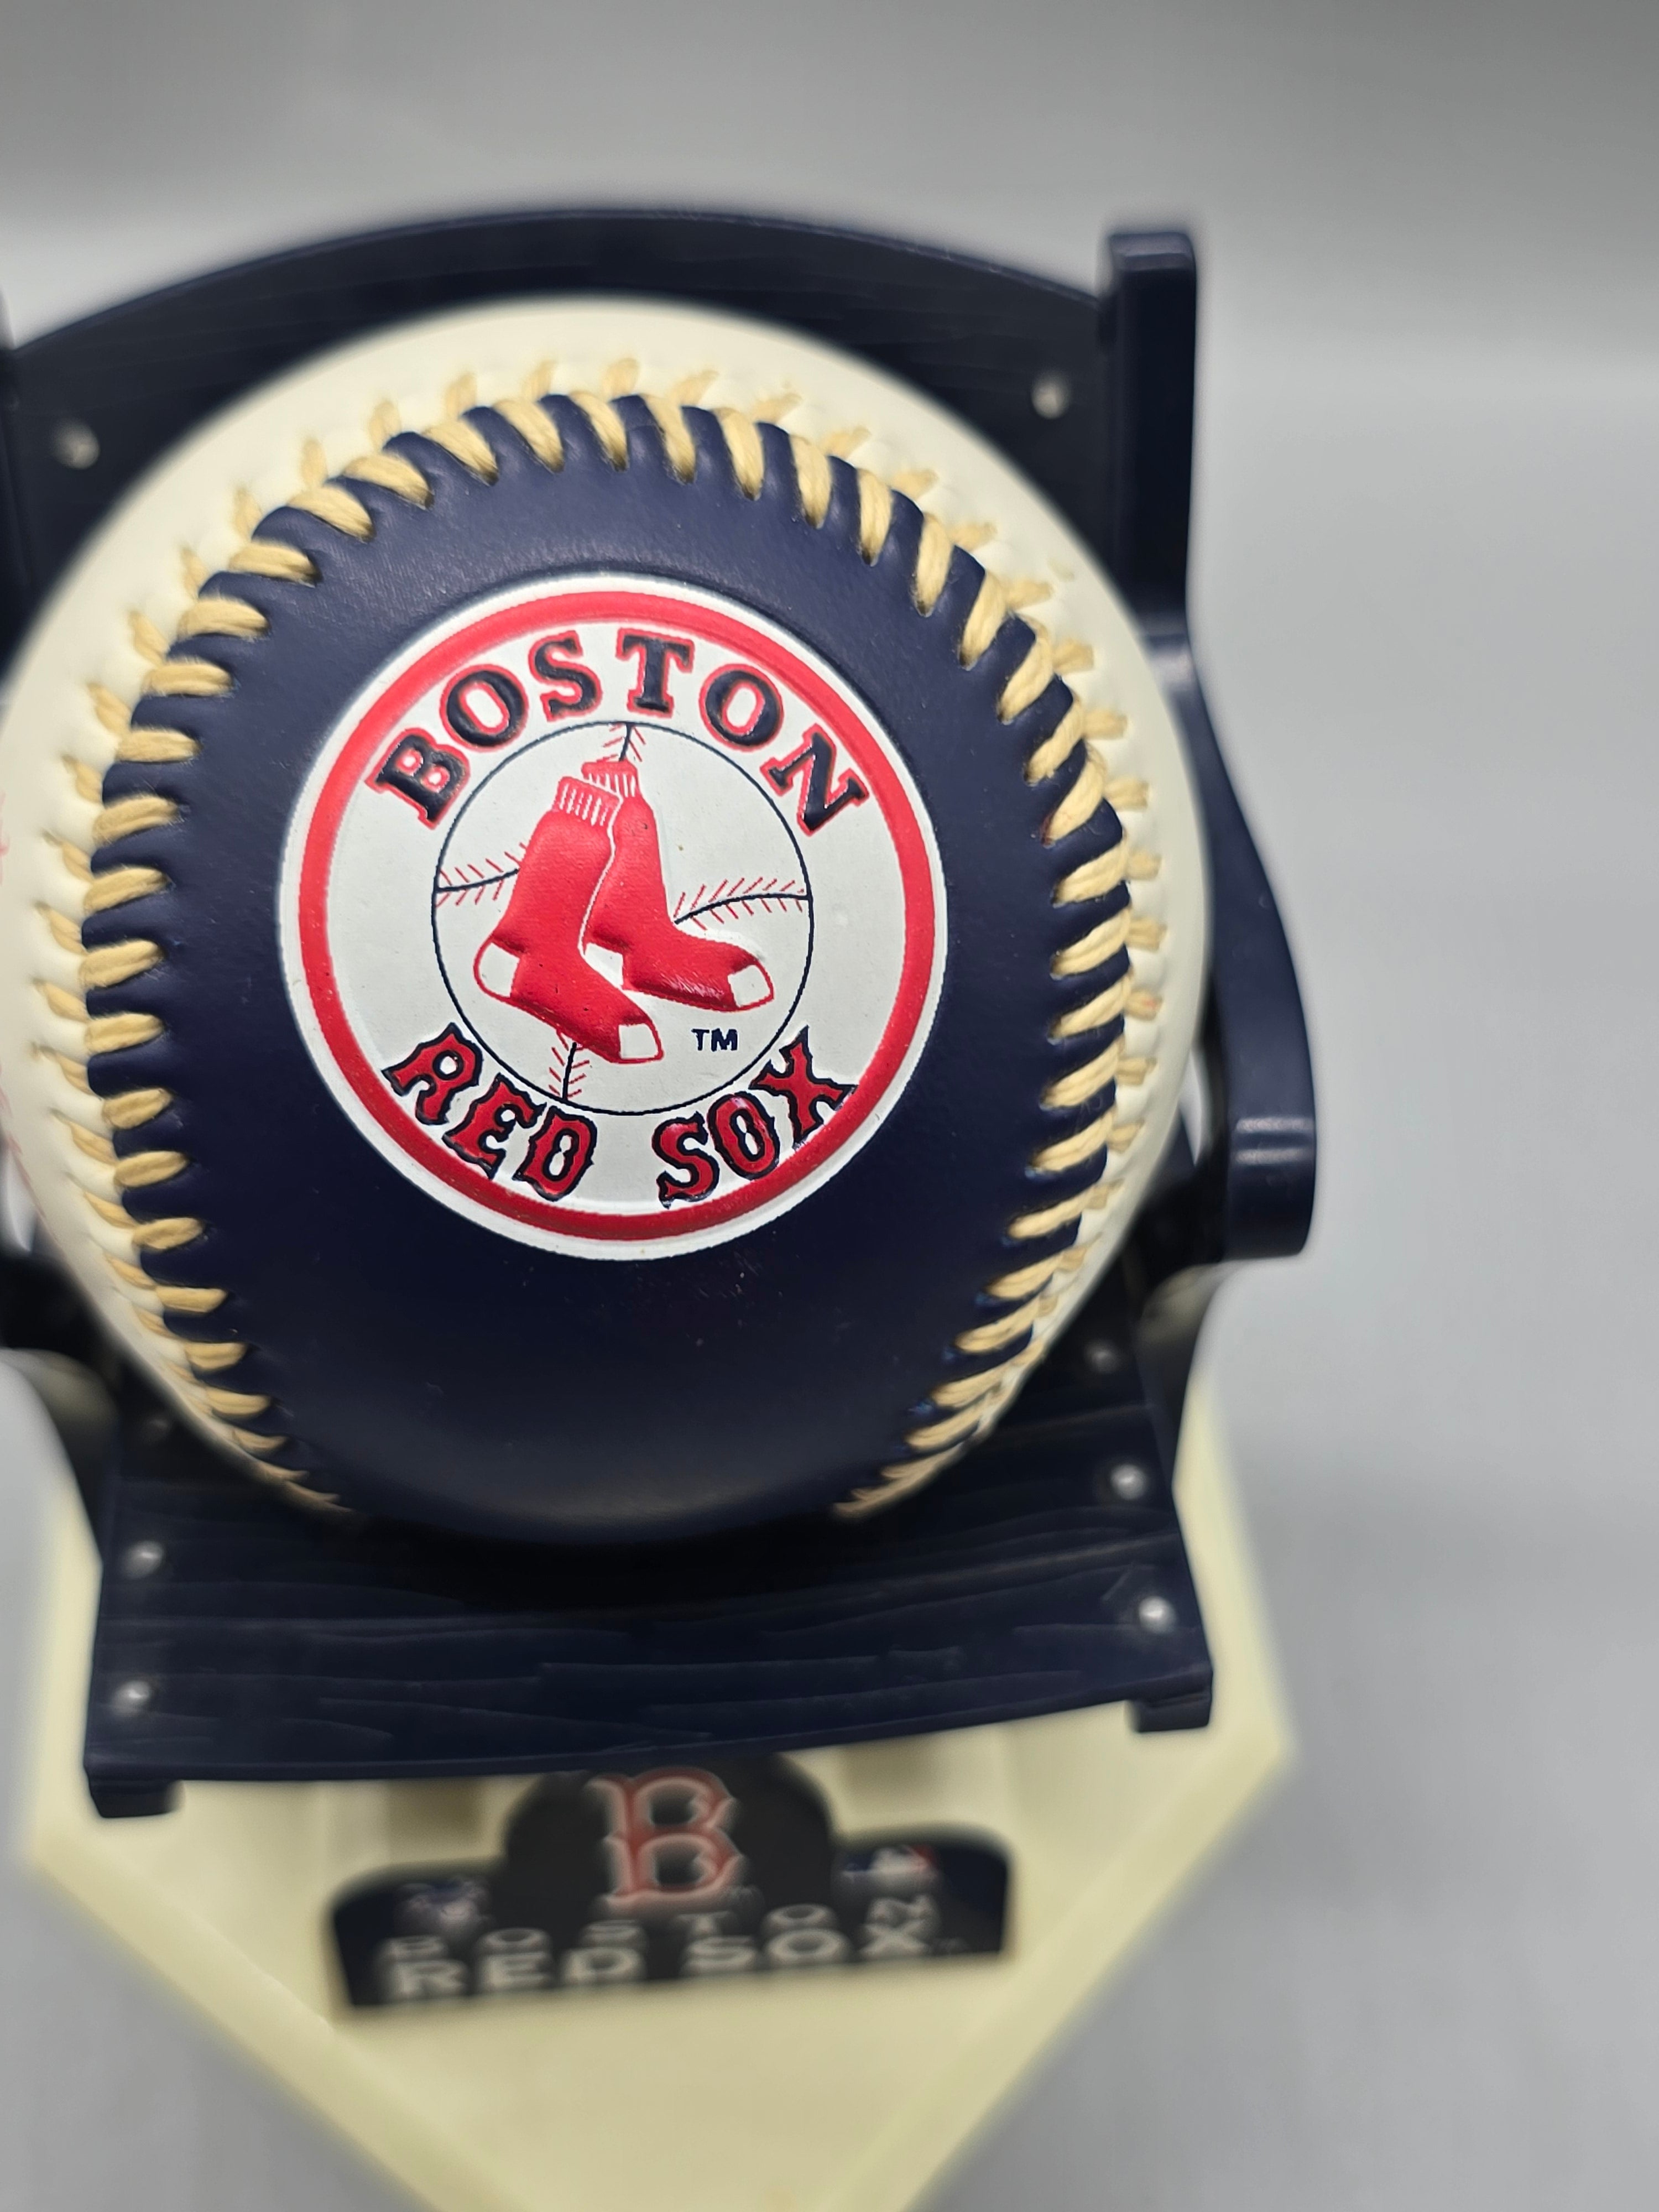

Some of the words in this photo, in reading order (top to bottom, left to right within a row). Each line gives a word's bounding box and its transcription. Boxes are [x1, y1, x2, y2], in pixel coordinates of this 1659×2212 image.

[368, 628, 869, 834] BOSTON
[692, 1027, 739, 1052] TM
[383, 1023, 598, 1201] RED
[652, 1026, 858, 1207] SOX
[588, 1768, 742, 1911] B
[387, 1945, 643, 2001] RED
[683, 1924, 927, 1970] SOX
